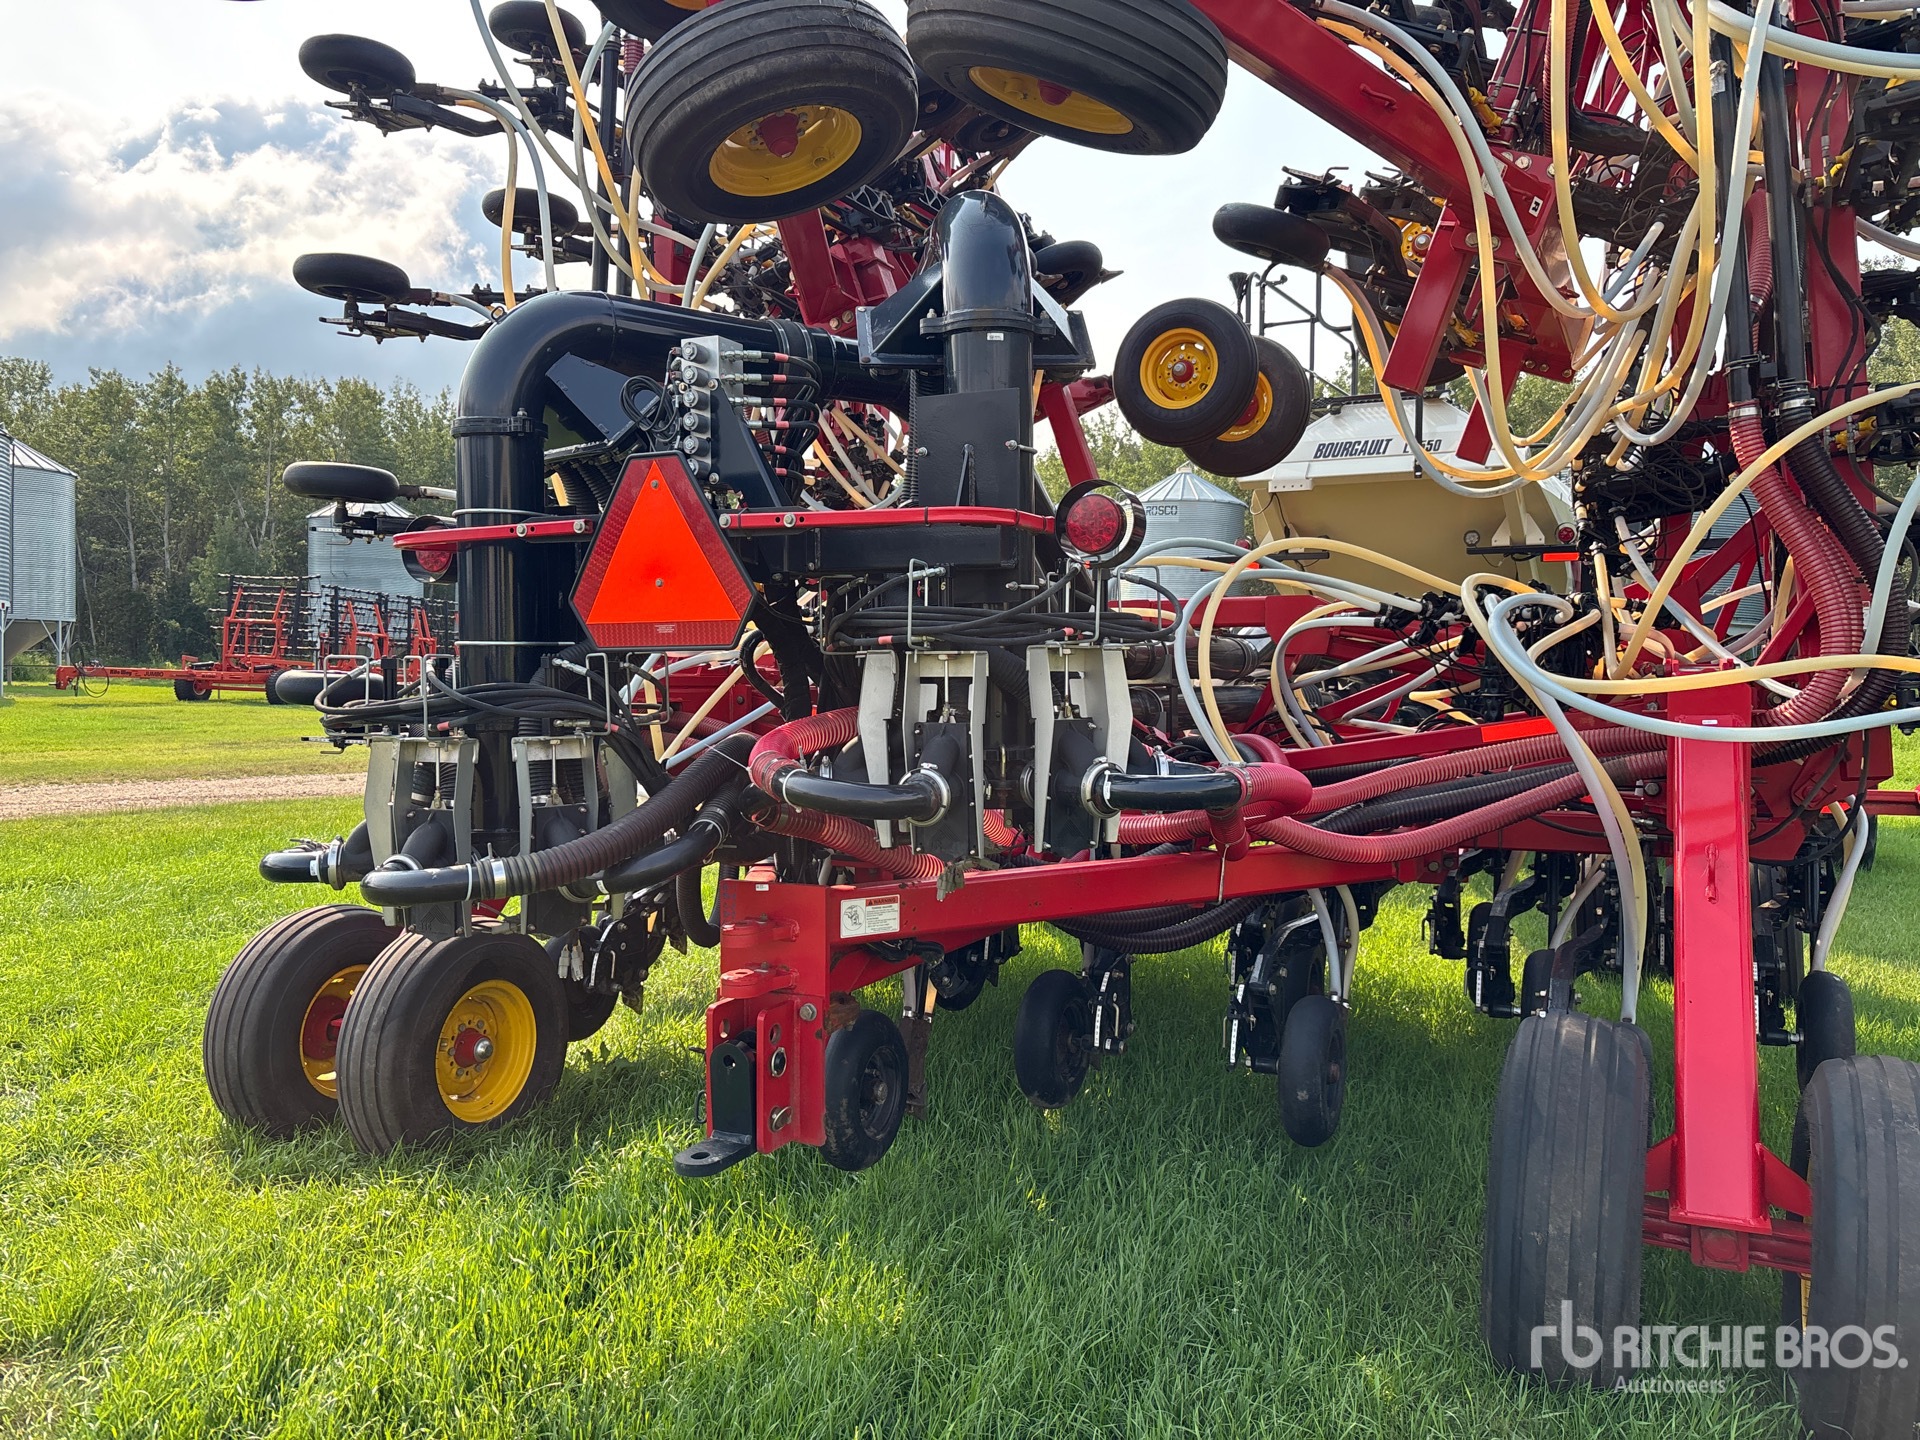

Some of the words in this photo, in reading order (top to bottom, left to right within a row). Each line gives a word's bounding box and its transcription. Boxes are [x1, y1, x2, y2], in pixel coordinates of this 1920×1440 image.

[1313, 437, 1394, 459] BOURGAULT
[1145, 505, 1178, 516] ROSCO
[873, 896, 896, 905] WARNING
